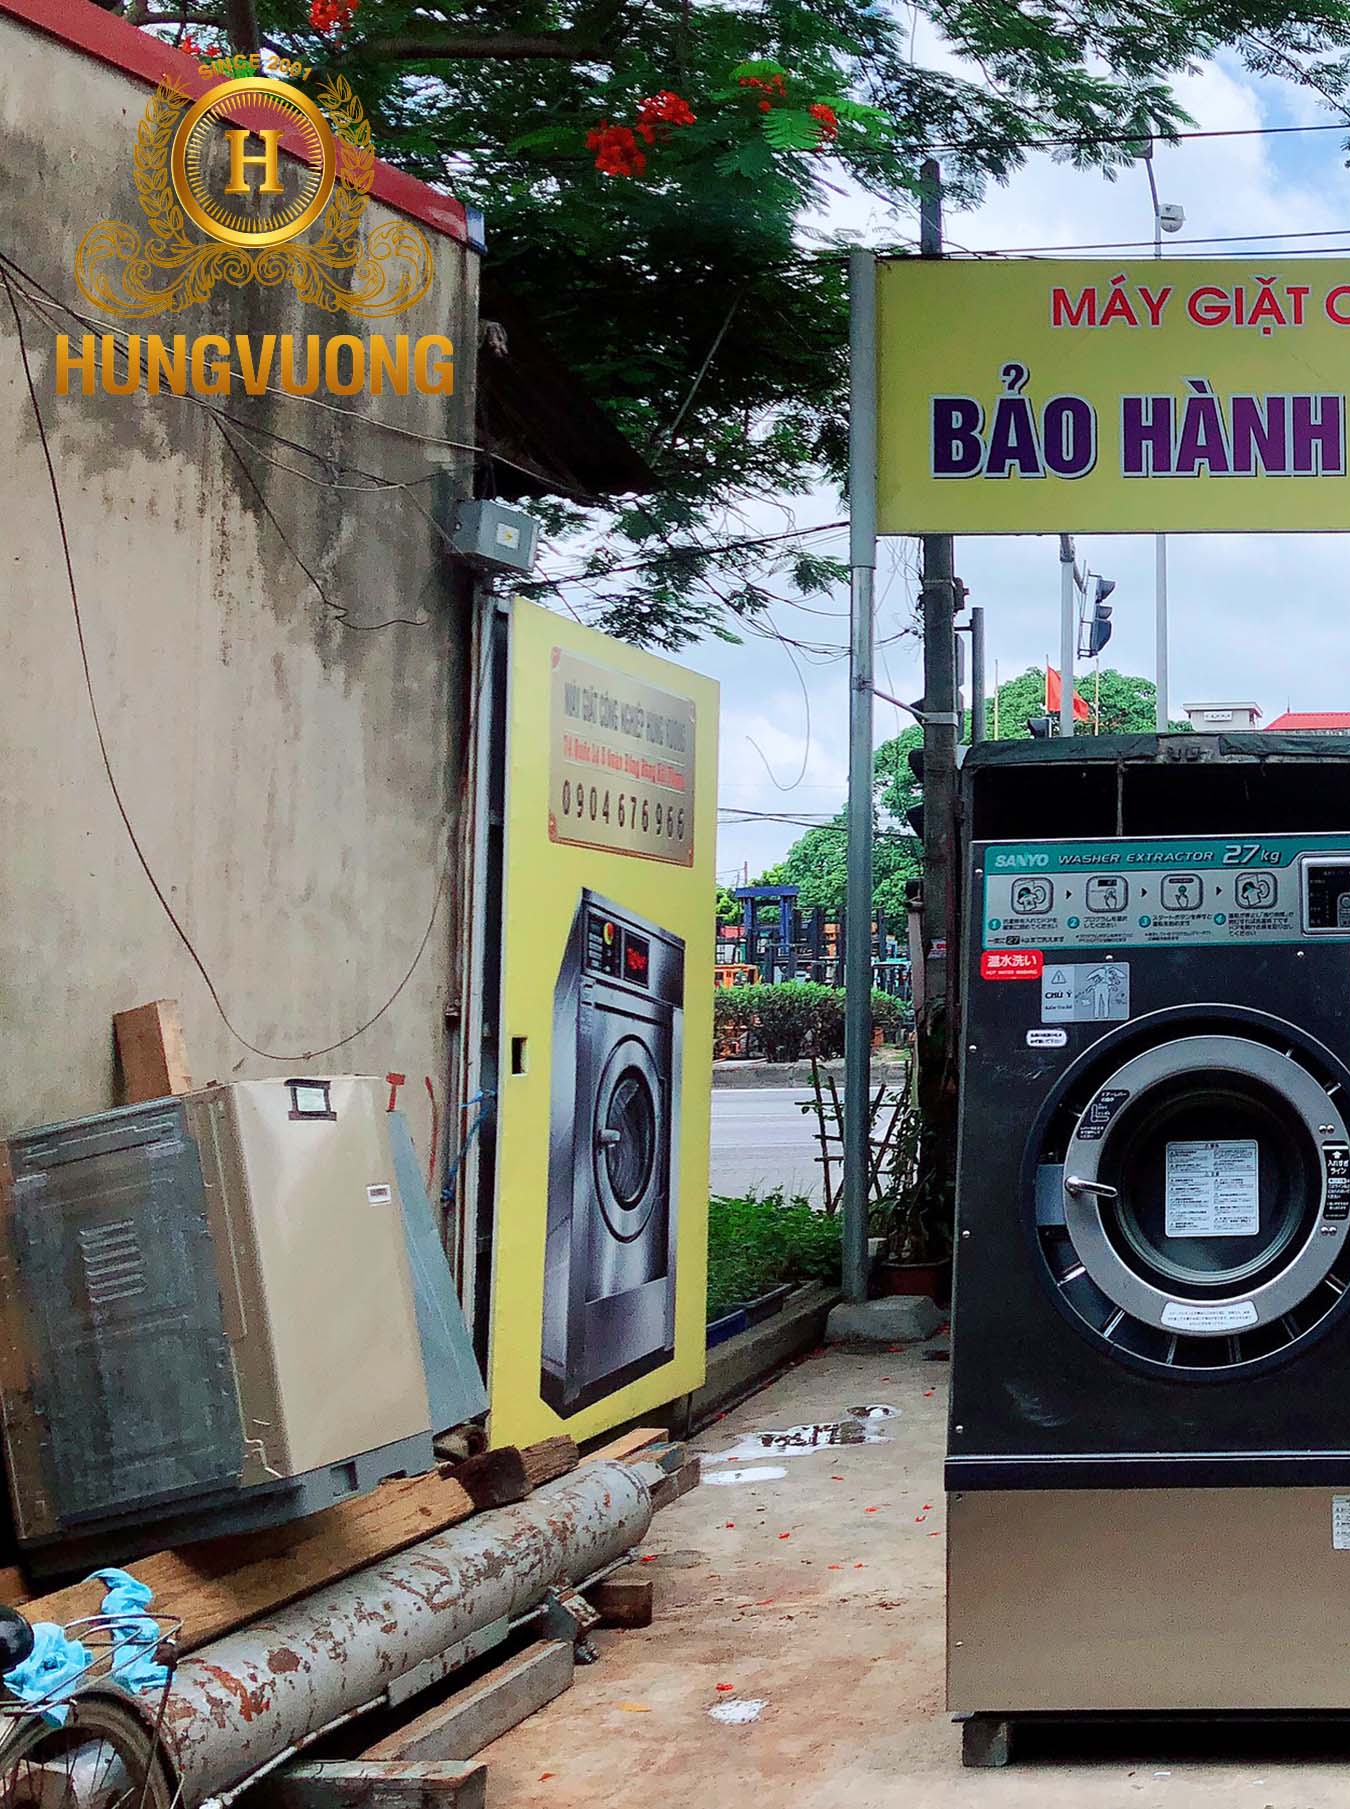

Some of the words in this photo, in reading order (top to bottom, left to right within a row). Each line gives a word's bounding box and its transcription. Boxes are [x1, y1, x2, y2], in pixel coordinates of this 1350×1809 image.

[1051, 275, 1171, 328] MÁY
[1187, 276, 1310, 337] GIẶT
[931, 363, 1097, 479] BẢO
[1120, 376, 1347, 479] HÀNH
[562, 780, 610, 824] 0904
[618, 794, 649, 832] 676
[995, 854, 1049, 867] SANYO
[1059, 853, 1121, 865] WASHER
[1126, 851, 1214, 863] EXTRACTOR
[987, 955, 1037, 967] 温水洗い
